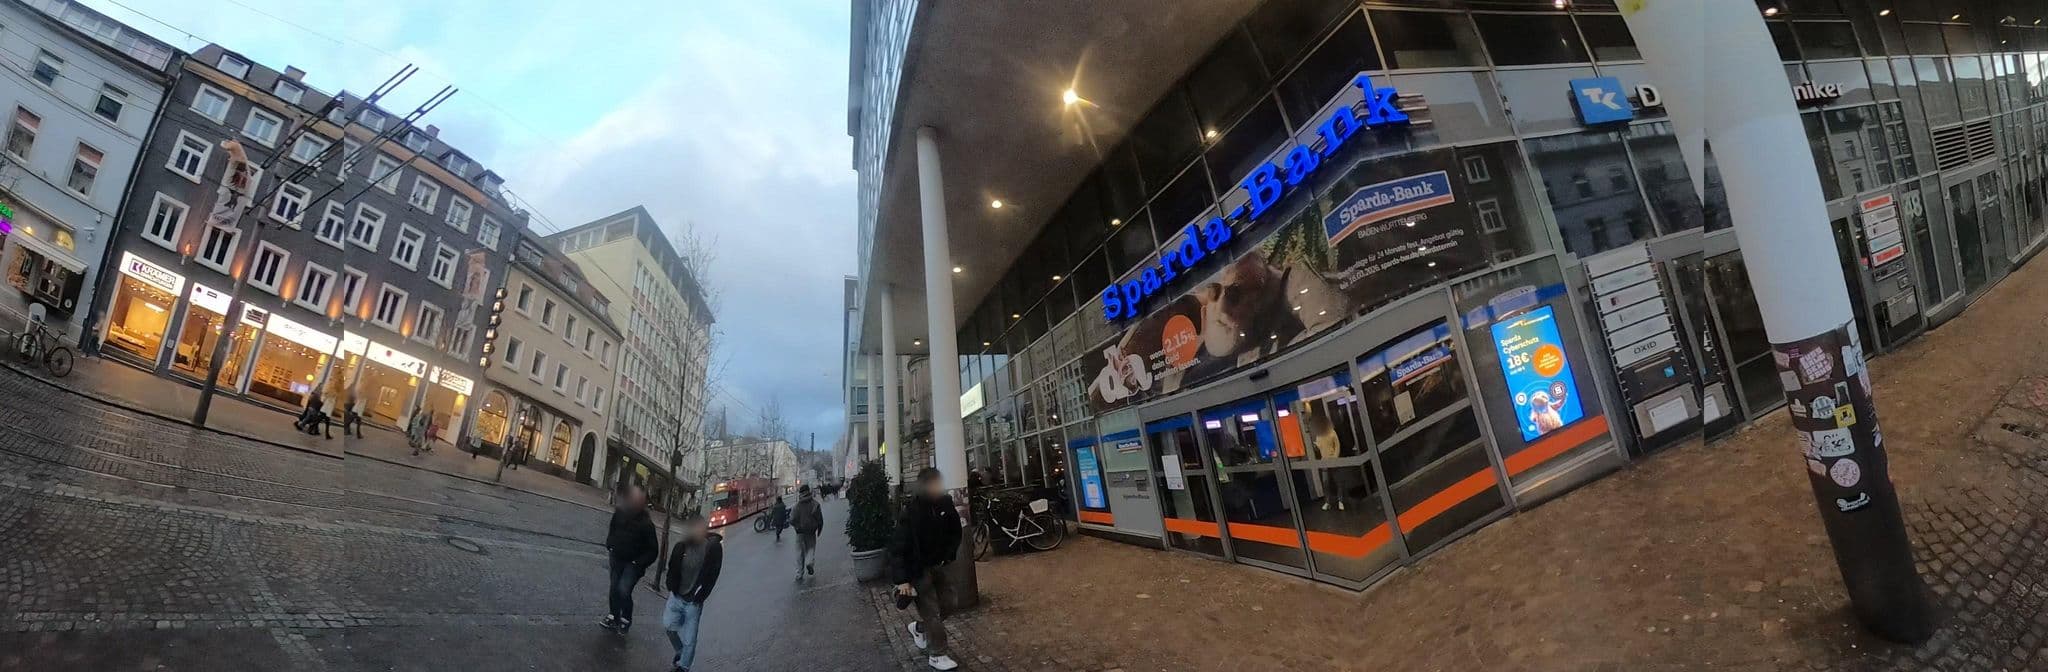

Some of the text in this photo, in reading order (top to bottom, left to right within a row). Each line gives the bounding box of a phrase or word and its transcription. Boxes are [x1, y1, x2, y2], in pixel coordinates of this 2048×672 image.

[1581, 87, 1623, 110] TK
[1637, 80, 1845, 107] D niker
[1101, 74, 1409, 319] Sparda-Bank
[1340, 181, 1434, 224] Sparda-Bank
[1633, 341, 1657, 354] OXID
